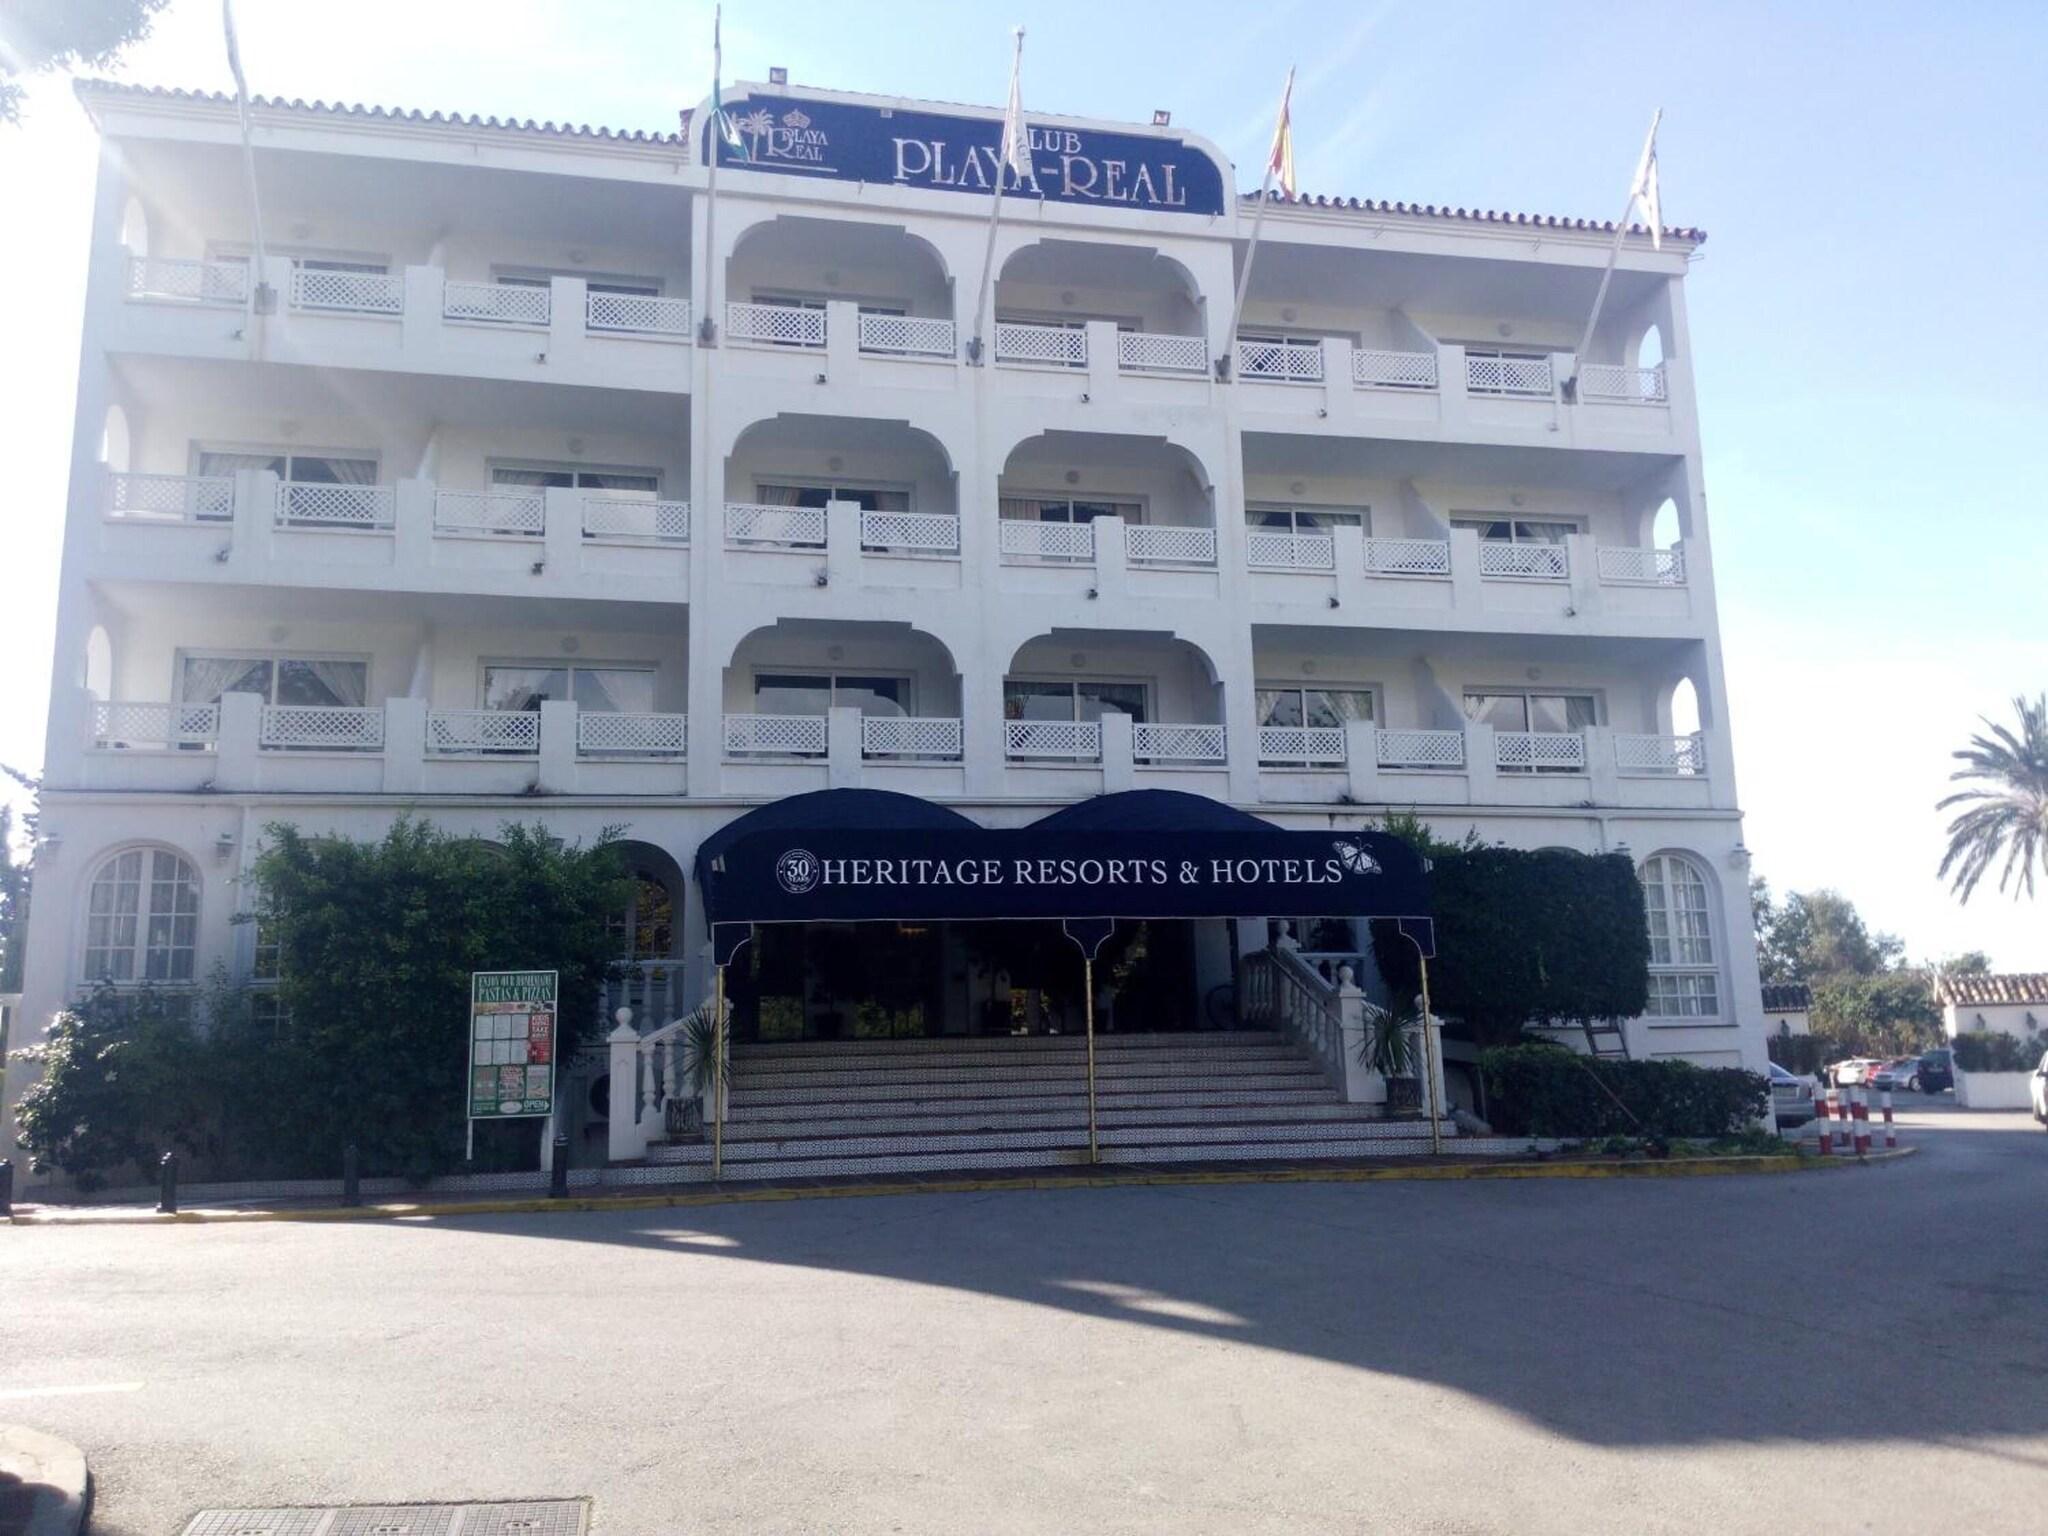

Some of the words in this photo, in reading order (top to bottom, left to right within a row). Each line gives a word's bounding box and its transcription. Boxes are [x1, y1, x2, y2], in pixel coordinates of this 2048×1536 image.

[782, 128, 829, 146] PLAYA
[1028, 128, 1082, 154] LUB
[787, 859, 810, 877] 30
[822, 859, 1004, 885] HERITAGE
[1014, 859, 1168, 885] RESORTS
[1179, 861, 1200, 884] &
[1210, 859, 1343, 884] HOTELS
[501, 975, 515, 987] OUR
[479, 987, 512, 1001] PASTAS
[522, 986, 552, 1000] PIZZAS
